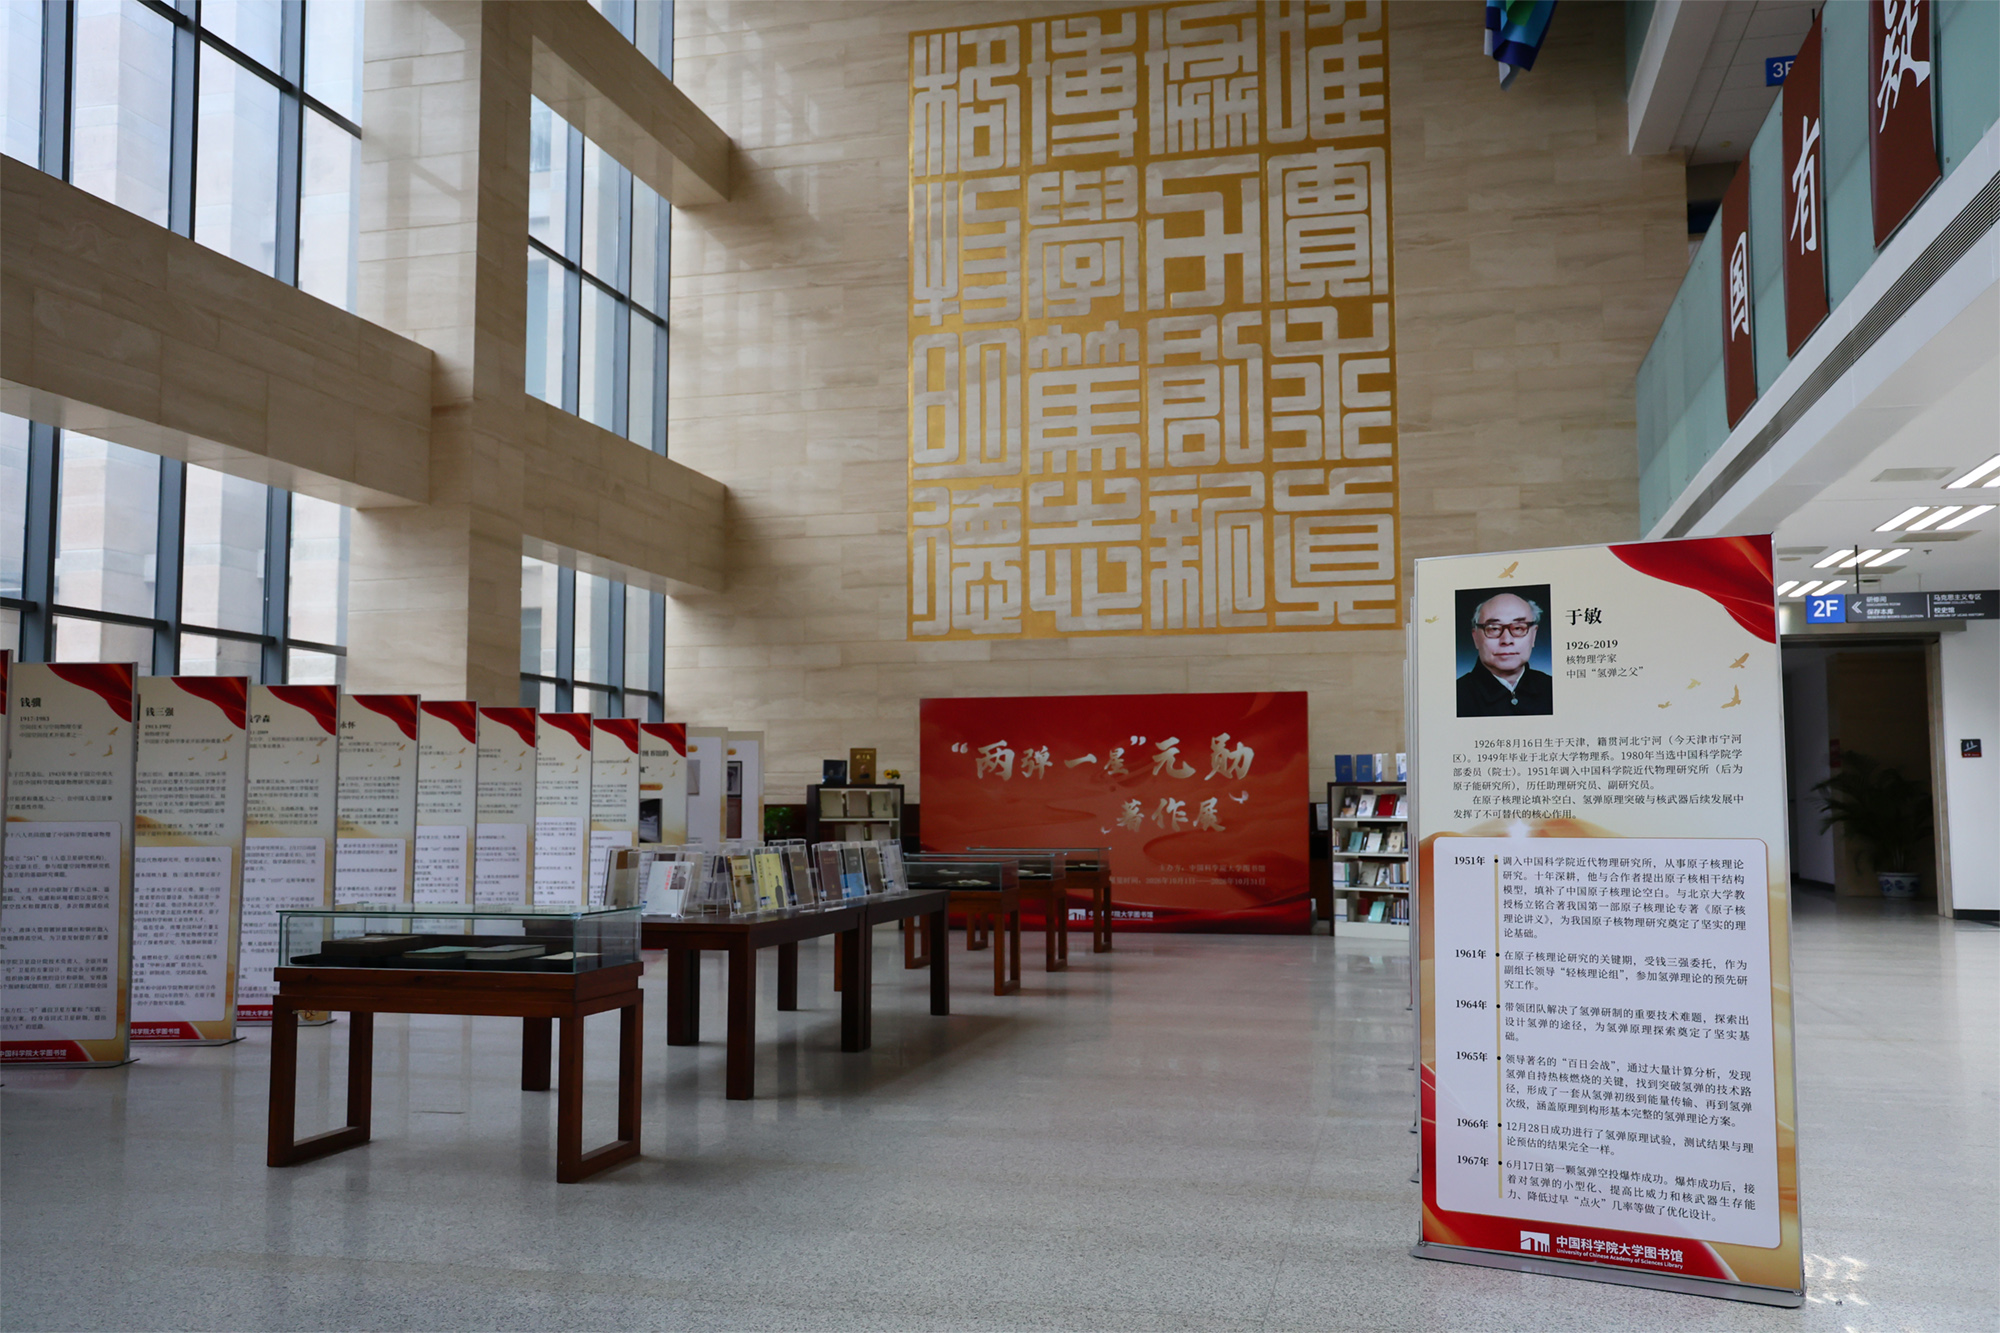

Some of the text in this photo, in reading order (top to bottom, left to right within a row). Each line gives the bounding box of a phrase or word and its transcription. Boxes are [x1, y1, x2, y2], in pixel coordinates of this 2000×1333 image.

[1790, 116, 1820, 255] 有
[1813, 600, 1838, 618] 2F
[1565, 607, 1603, 625] 于敏
[1566, 639, 1618, 650] 1926-2019
[1566, 654, 1617, 665] 核物理学家
[146, 707, 174, 717] 钱三强
[1116, 797, 1226, 832] 著作展
[1453, 809, 1577, 820] 发挥了不可替代的核心作用。
[1454, 856, 1486, 866] 1951年
[1503, 928, 1539, 939] 论基础。
[1455, 949, 1487, 959] 1961年
[1504, 979, 1539, 991] 究工作。
[1455, 1000, 1487, 1010] 1964年
[1505, 1031, 1520, 1042] 础。
[1456, 1051, 1488, 1062] 1965年
[1457, 1118, 1488, 1130] 1966年
[1457, 1155, 1489, 1167] 1967年
[1556, 1235, 1683, 1262] 中国科学院大学图书馆
[1556, 1248, 1582, 1257] University
[1589, 1252, 1609, 1260] Chinese
[1610, 1254, 1633, 1263] Academy
[1641, 1258, 1664, 1267] Sciences
[1664, 1261, 1683, 1269] Library
